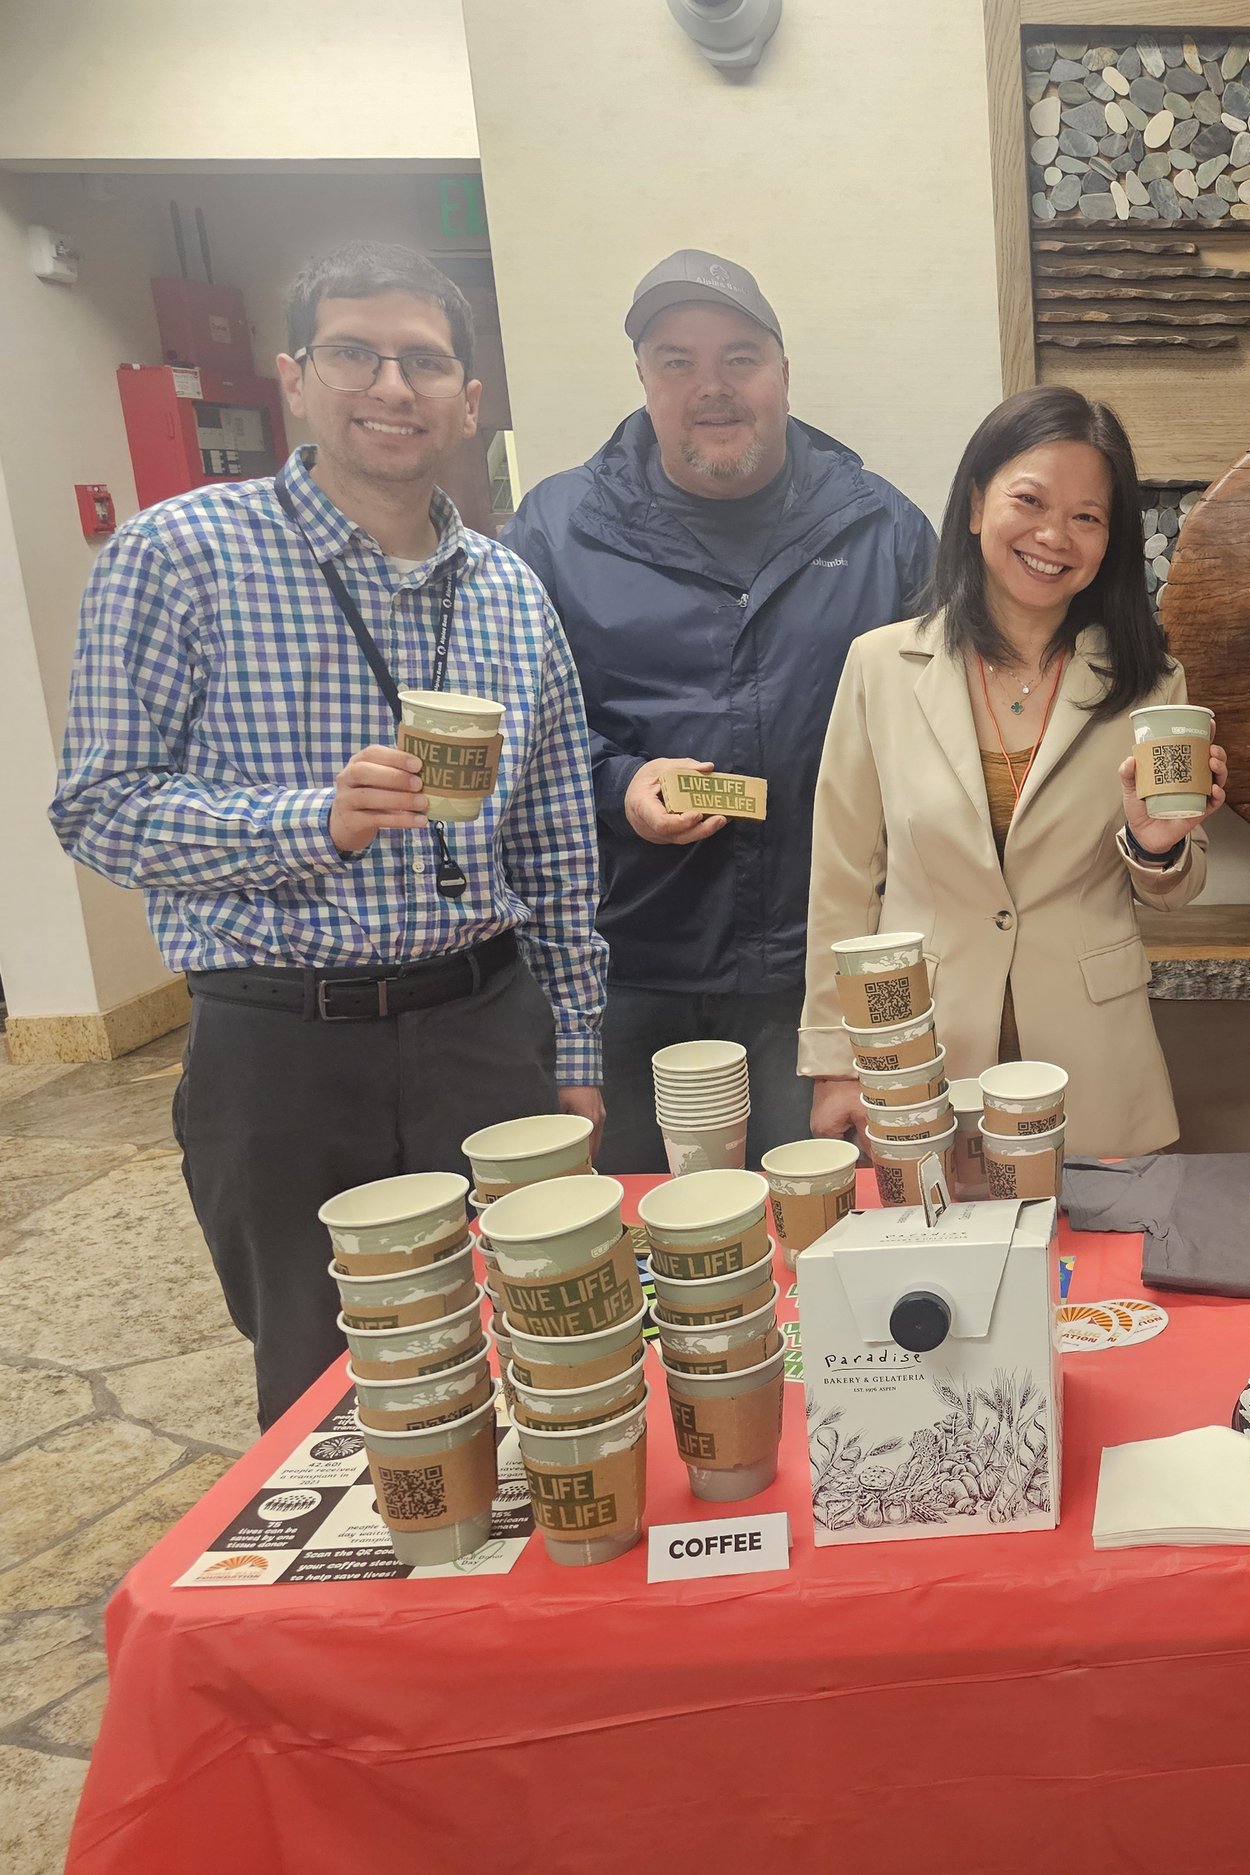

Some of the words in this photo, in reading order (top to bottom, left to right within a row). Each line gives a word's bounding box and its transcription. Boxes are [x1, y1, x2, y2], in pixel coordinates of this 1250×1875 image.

[439, 176, 484, 236] EX
[405, 737, 440, 763] LIVE
[446, 746, 486, 766] LIFE
[421, 766, 455, 788] IVE
[460, 770, 491, 789] LIFE
[680, 776, 711, 791] LIVE
[714, 779, 743, 795] LIFE
[693, 793, 723, 808] GIVE
[726, 796, 755, 812] LIFE
[687, 1247, 740, 1279] LIFE
[506, 1285, 555, 1312] LIVE
[560, 1266, 614, 1308] LIFE
[589, 1283, 633, 1328] LIFE
[825, 1350, 922, 1367] Paradise
[824, 1377, 861, 1385] BAKERY
[872, 1374, 925, 1383] GELATERIA
[678, 1434, 713, 1458] LIFE
[538, 1476, 587, 1500] LIFE
[559, 1499, 613, 1528] LIFE
[238, 1527, 264, 1535] lives
[261, 1534, 275, 1543] by
[303, 1551, 332, 1559] Scan
[669, 1531, 762, 1559] COFFEE
[296, 1564, 326, 1572] your
[326, 1560, 368, 1570] coffee
[305, 1574, 332, 1582] help
[362, 1571, 397, 1579] lives!
